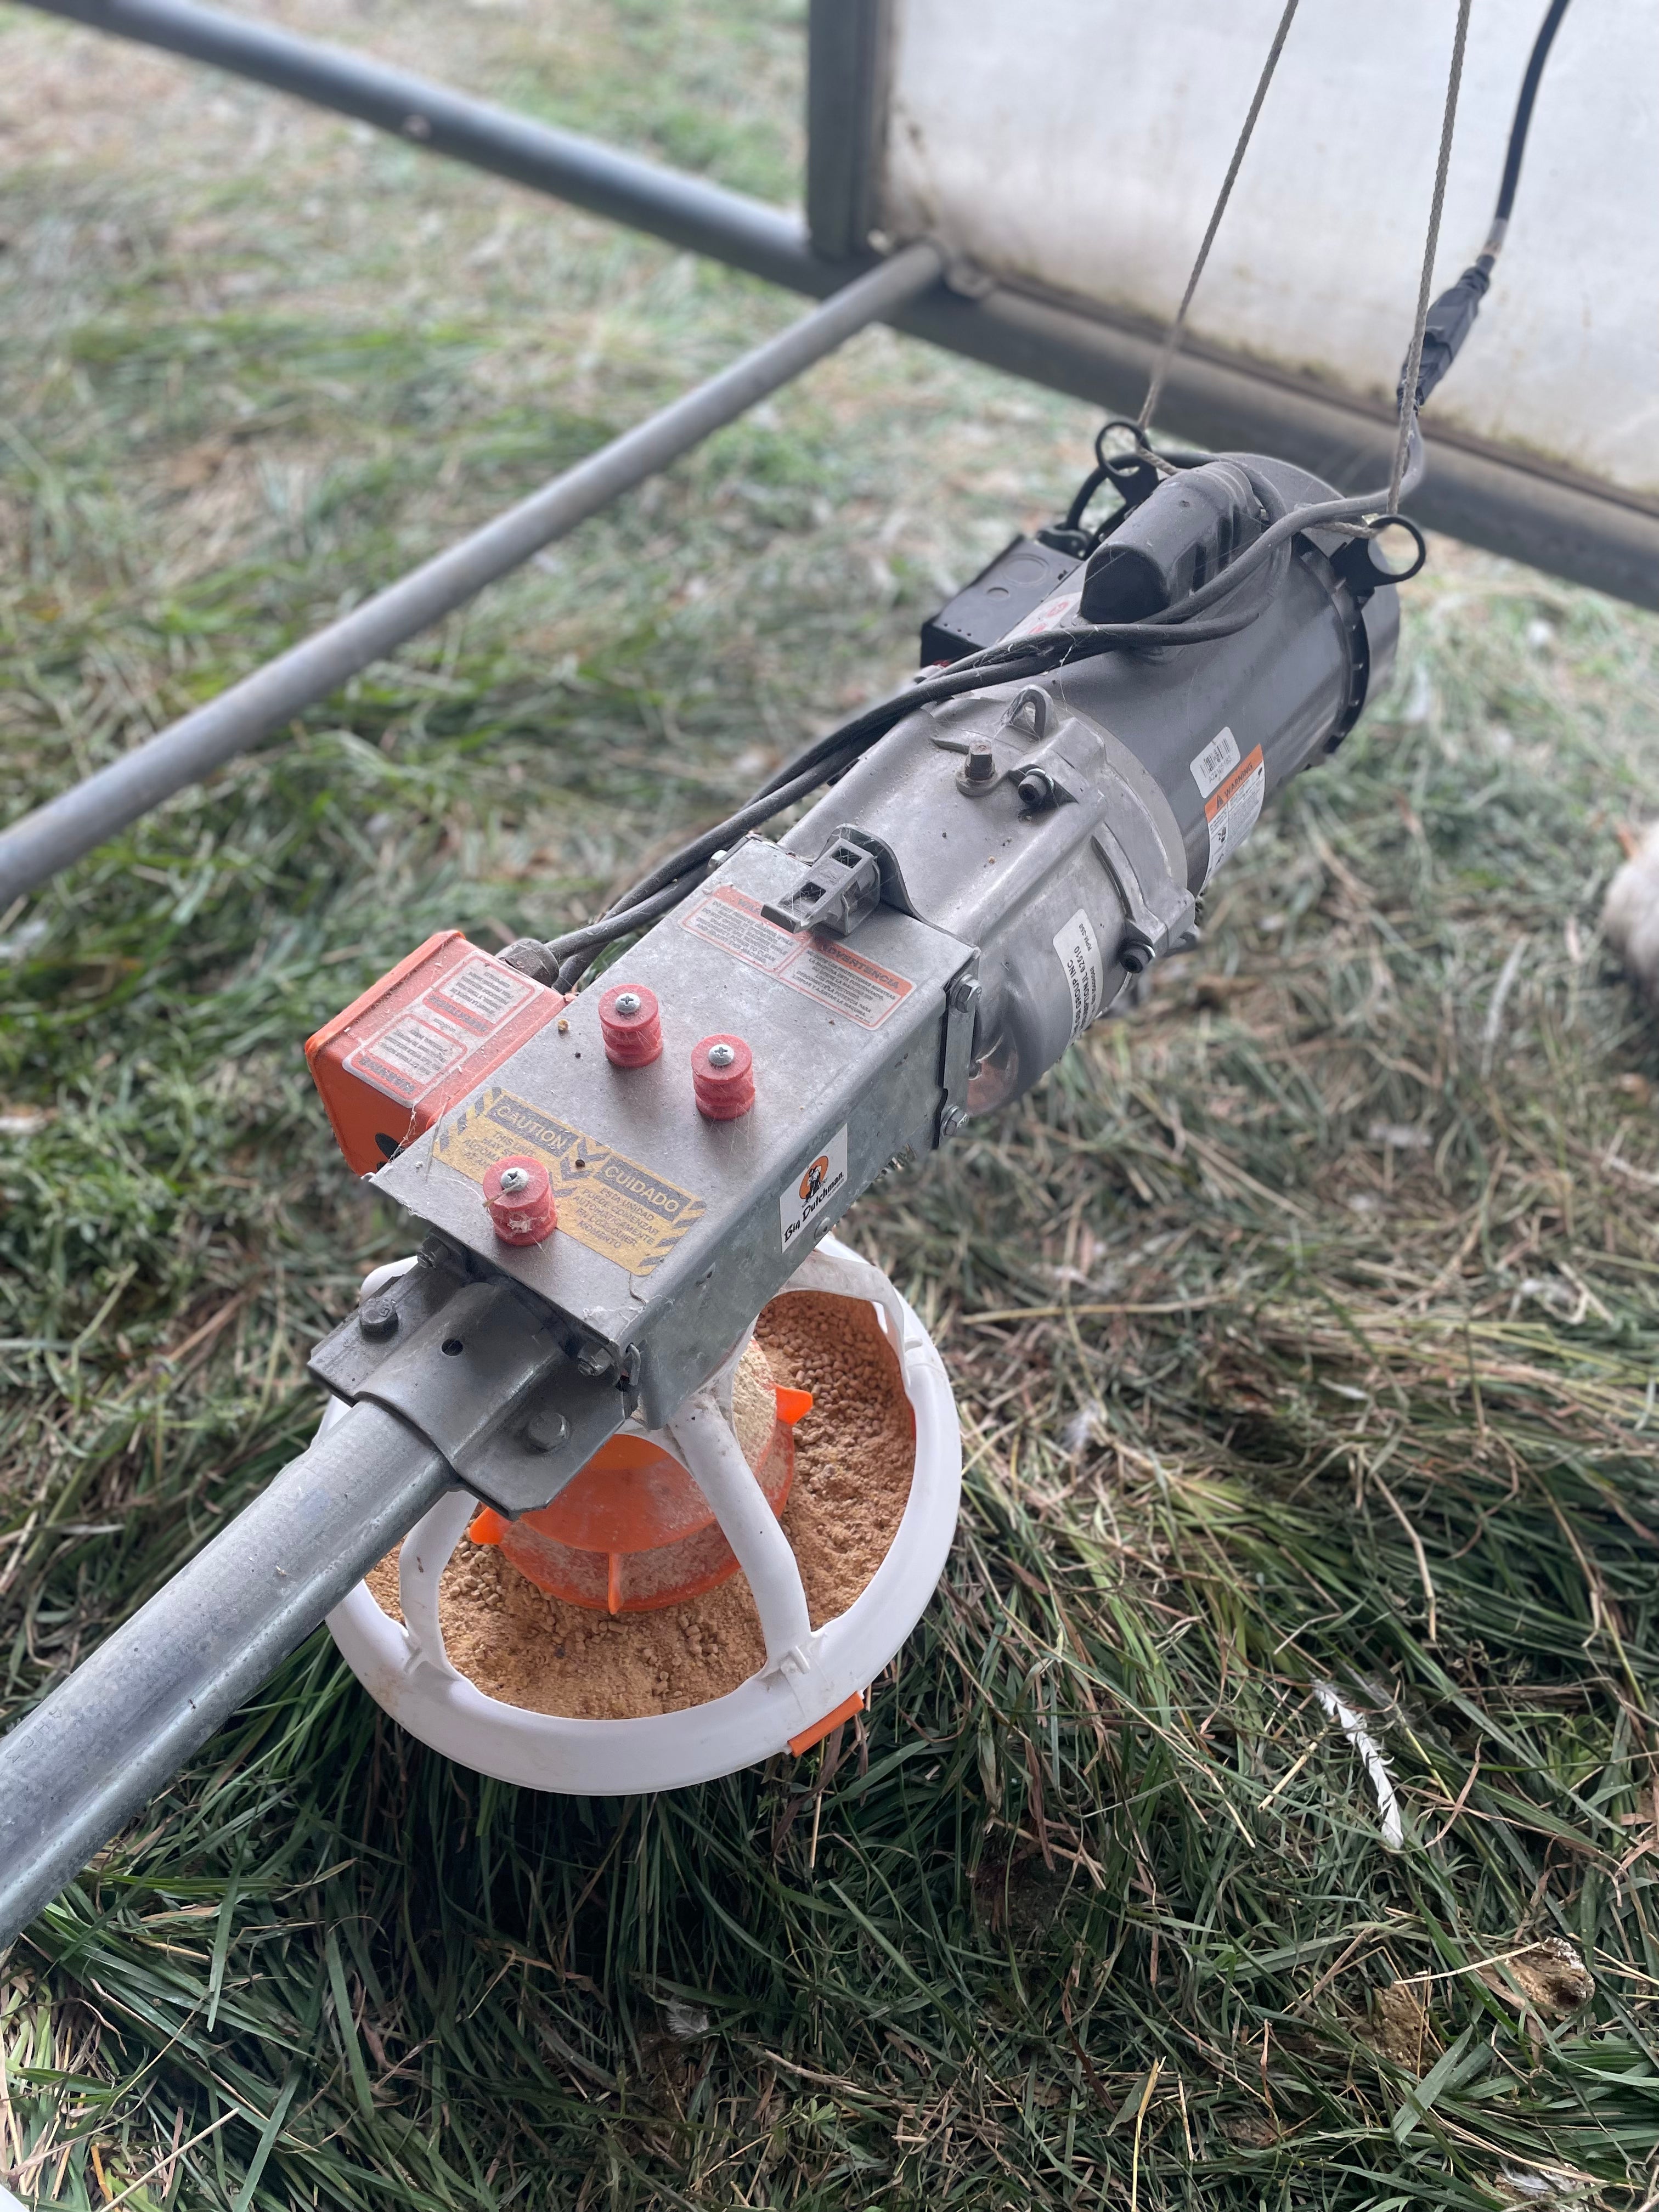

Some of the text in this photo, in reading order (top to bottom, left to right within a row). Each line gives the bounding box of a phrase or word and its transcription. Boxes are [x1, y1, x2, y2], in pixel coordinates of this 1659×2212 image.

[1224, 761, 1252, 797] WARNING
[1067, 959, 1077, 977] INC
[1074, 946, 1086, 971] 62510
[1072, 979, 1082, 1011] GROUP
[492, 1131, 515, 1147] THIS
[494, 1104, 568, 1150] CAUTION
[599, 1187, 656, 1222] ESTA UNIDAD
[602, 1164, 682, 1214] CUIDADO
[571, 1194, 657, 1245] AUTOMATICAMENTE
[581, 1188, 660, 1236] PUEDE COMENZAR
[576, 1220, 623, 1249] MOMENTO
